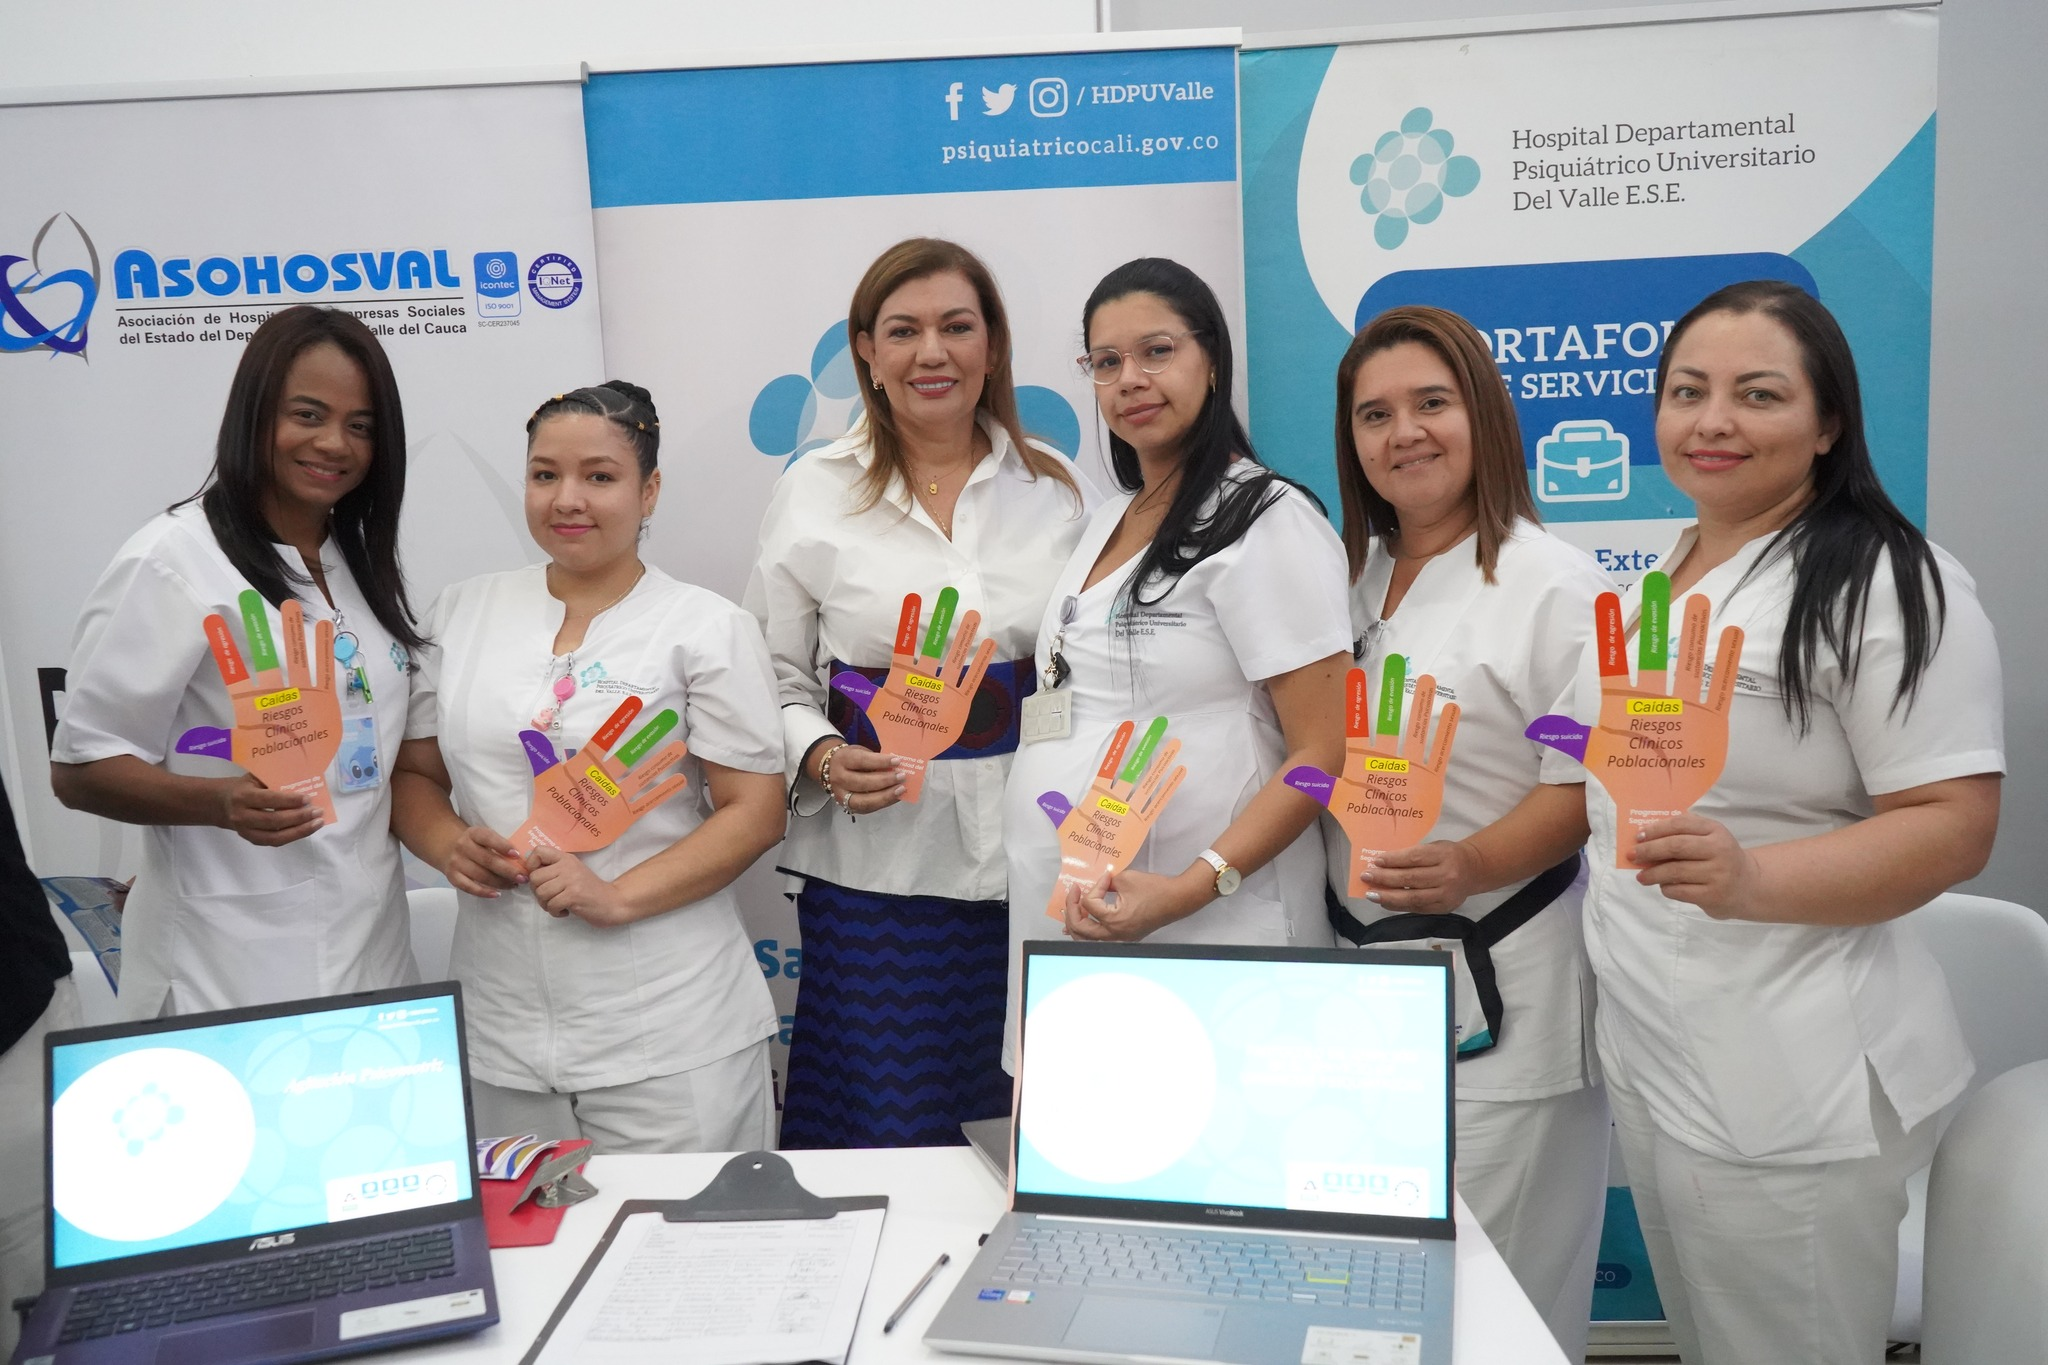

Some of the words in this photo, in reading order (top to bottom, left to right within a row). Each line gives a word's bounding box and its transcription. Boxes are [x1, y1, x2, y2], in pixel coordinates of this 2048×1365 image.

[1091, 81, 1214, 104] HDPUValle
[1512, 125, 1609, 151] Hospital
[1615, 113, 1795, 145] Departamental
[942, 135, 1219, 164] psiquiatricocali.gov.co
[1512, 155, 1650, 182] Psiquiátrico
[1656, 144, 1816, 172] Universitario
[1513, 189, 1552, 211] Del
[1558, 186, 1620, 208] Valle
[1625, 183, 1685, 206] E.S.E.
[531, 256, 577, 275] CERTIFIED
[480, 281, 515, 289] icontec
[117, 313, 195, 327] Asociación
[203, 313, 221, 325] de
[407, 304, 465, 317] Sociales
[119, 333, 140, 345] del
[145, 331, 195, 344] Estado
[200, 330, 221, 342] del
[369, 324, 394, 336] alle
[399, 322, 421, 335] del
[424, 321, 467, 335] Cauca
[1595, 549, 1659, 571] Exte
[1606, 607, 1617, 634] agresión
[1650, 600, 1658, 623] evasión
[1650, 624, 1656, 632] de
[1608, 635, 1615, 643] de
[1650, 633, 1658, 653] Riesgo
[1608, 645, 1617, 666] Riesgo
[909, 676, 942, 691] Caídas
[904, 688, 940, 704] Riesgos
[262, 704, 303, 723] Riesgos
[900, 701, 938, 718] Clínicos
[1633, 701, 1680, 713] Caídas
[265, 719, 308, 738] Clínicos
[882, 711, 950, 734] Poblacionales
[1629, 718, 1682, 734] Riesgos
[251, 729, 329, 759] Poblacionales
[1629, 737, 1683, 750] Clínicos
[1369, 759, 1407, 772] Caídas
[1607, 755, 1706, 769] Poblacionales
[589, 769, 617, 796] Caídas
[1366, 773, 1408, 789] Riesgos
[578, 777, 609, 807] Riesgos
[1365, 788, 1407, 802] Clínicos
[568, 787, 600, 817] Clínicos
[1346, 802, 1424, 819] Poblacionales
[546, 786, 602, 838] Poblacionales
[1092, 810, 1122, 828] Riesgos
[1629, 809, 1669, 817] Programa
[1068, 830, 1122, 859] Poblacionales
